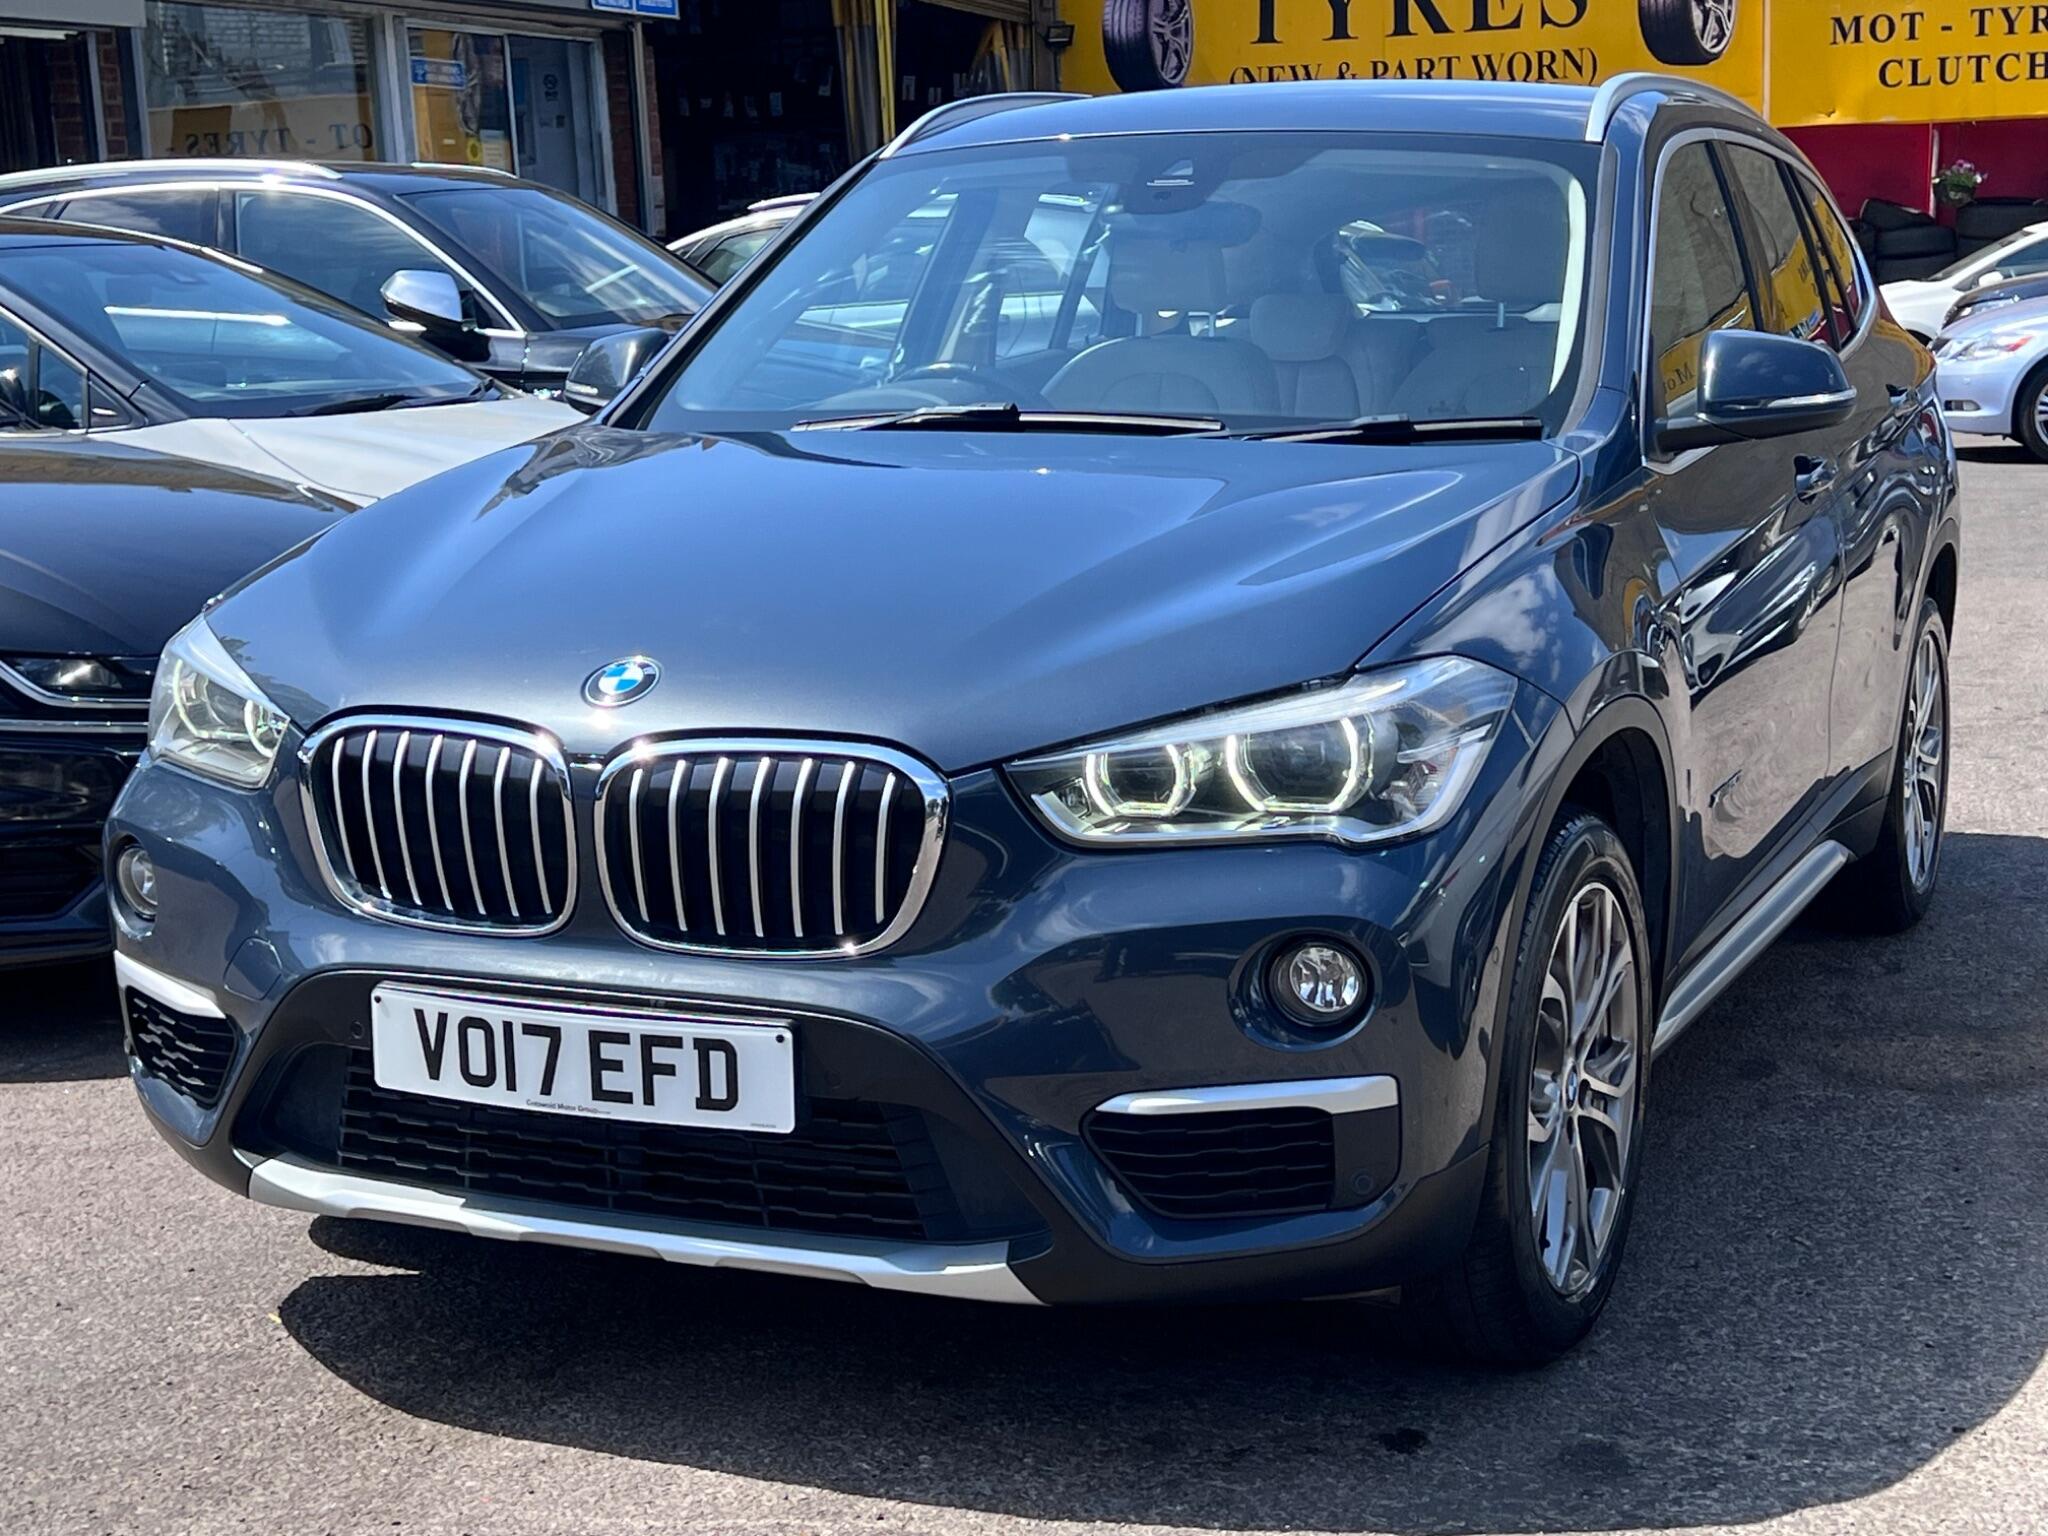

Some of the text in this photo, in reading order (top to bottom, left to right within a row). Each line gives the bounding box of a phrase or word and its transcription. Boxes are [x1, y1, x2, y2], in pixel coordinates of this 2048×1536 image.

[1830, 12, 1924, 45] MOT
[1370, 55, 1460, 80] PART
[1472, 47, 1598, 86] WORN)
[1878, 51, 2048, 88] CLUTCH
[414, 1008, 740, 1112] VO17 EFD
